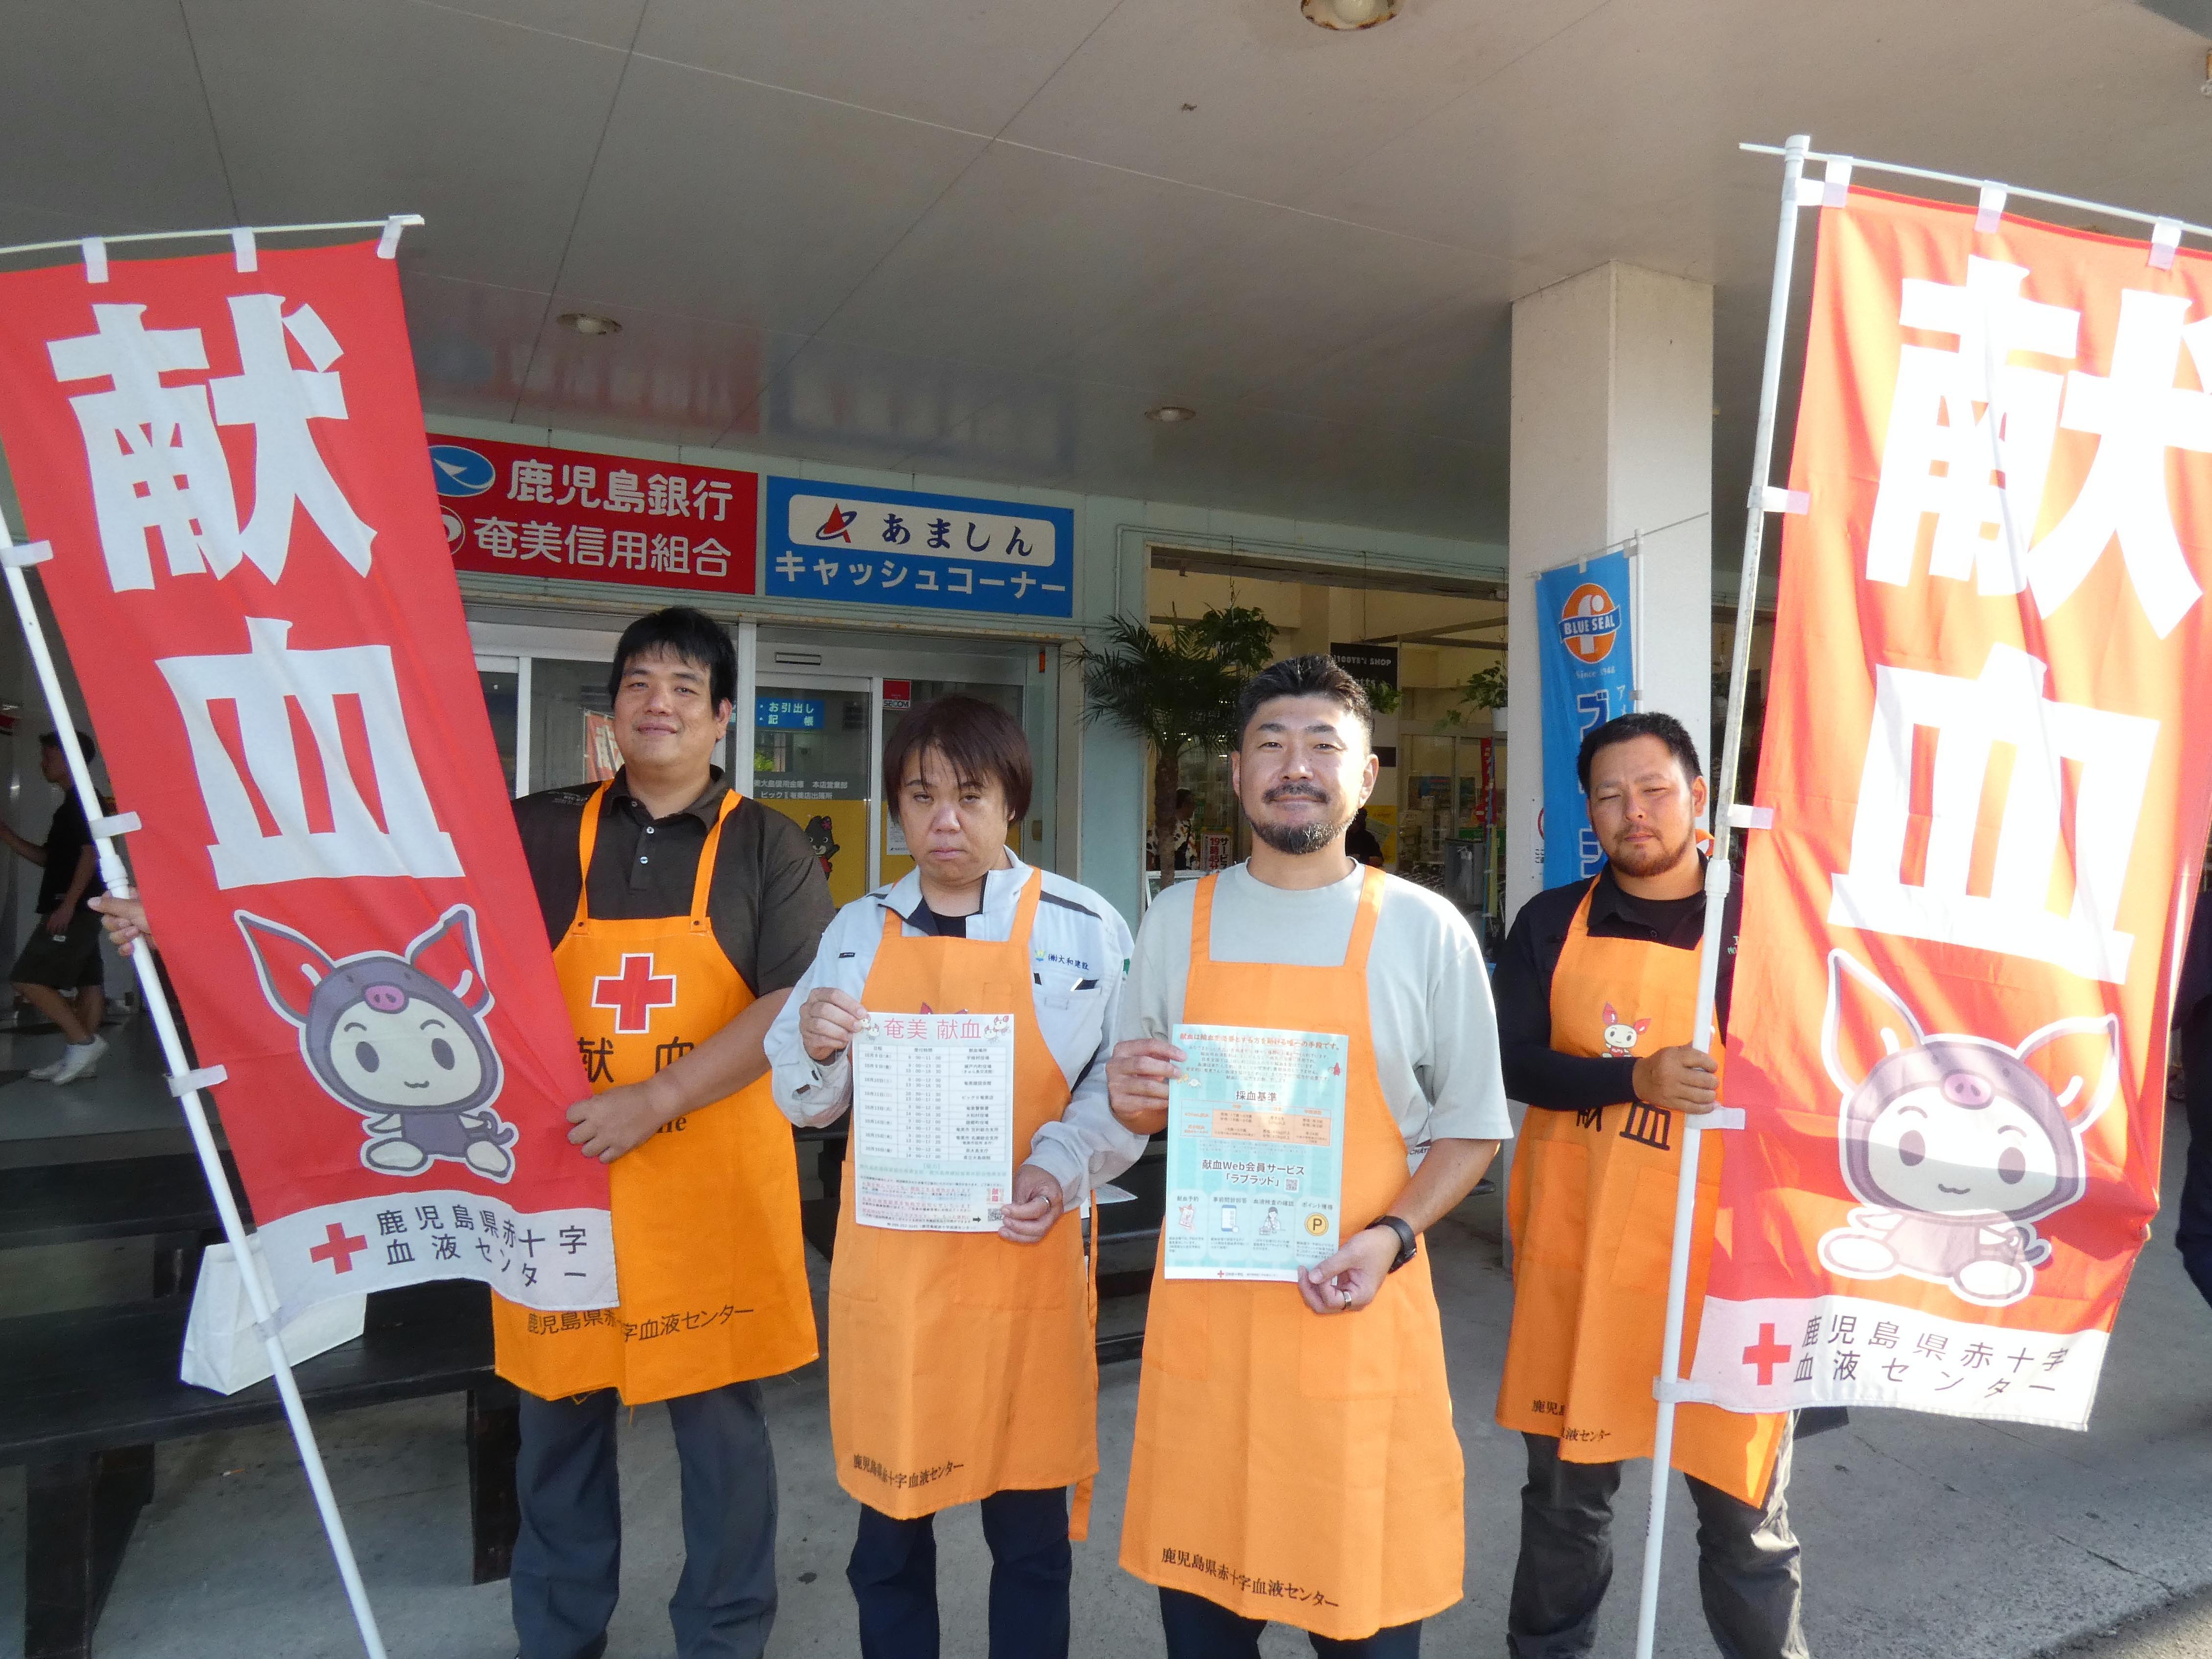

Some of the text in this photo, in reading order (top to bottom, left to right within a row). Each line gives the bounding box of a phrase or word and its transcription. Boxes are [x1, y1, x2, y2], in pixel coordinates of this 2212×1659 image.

[507, 458, 733, 521] 鹿児島銀行
[474, 516, 731, 577] 奄美信用組合
[883, 513, 1033, 557] あましん
[47, 294, 465, 890] 献血
[775, 551, 1065, 599] キャッシュコーナー
[1563, 614, 1615, 635] BLUE SEAL
[1827, 254, 2212, 984] 献血
[768, 702, 814, 714] お引出し
[884, 1018, 981, 1040] 奄美 献血
[1236, 1090, 1277, 1102] 採血基準
[1202, 1159, 1305, 1175] 献血Web会員サービス
[1226, 1173, 1279, 1186] 「ラブラッド」
[376, 1204, 587, 1257] 鹿児島県赤十字
[1313, 1218, 1322, 1231] P
[387, 1234, 587, 1287] 血液センター
[1802, 1314, 2069, 1373] 鹿児島県赤十字
[1793, 1350, 2056, 1398] 血液センター
[853, 1454, 964, 1489] 鹿児島県赤十字血液センター
[1161, 1547, 1339, 1607] 鹿児島県赤十字血液センター
